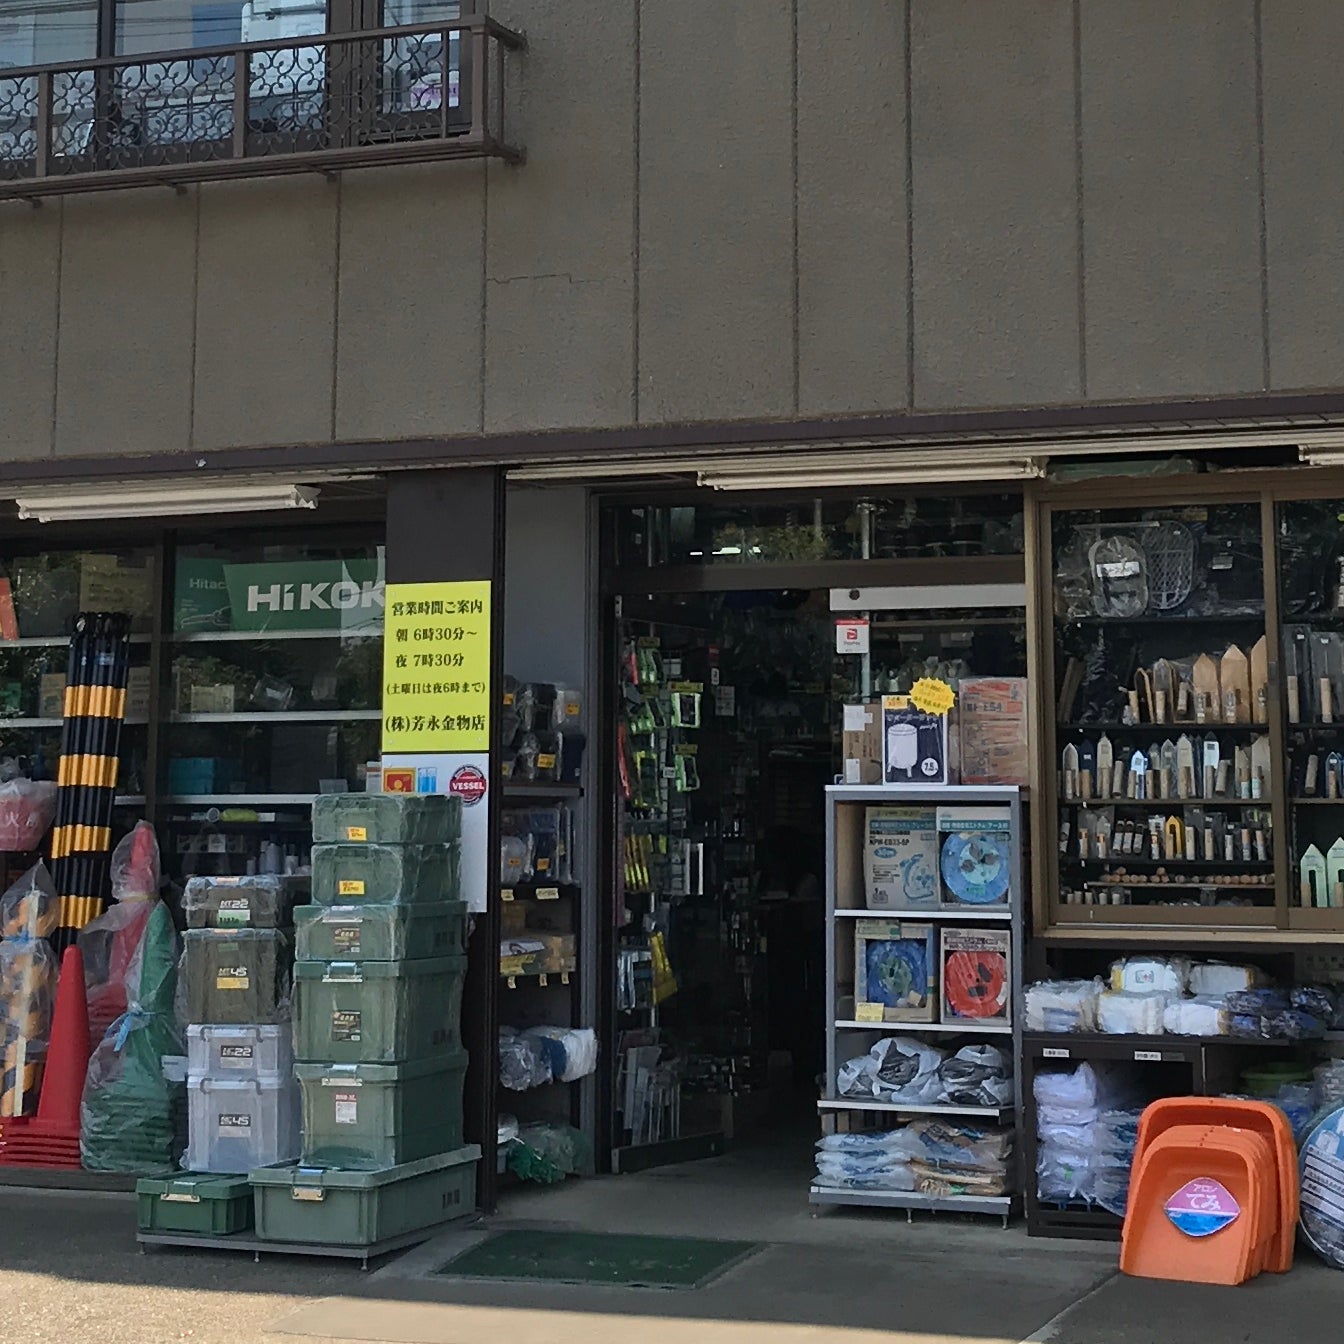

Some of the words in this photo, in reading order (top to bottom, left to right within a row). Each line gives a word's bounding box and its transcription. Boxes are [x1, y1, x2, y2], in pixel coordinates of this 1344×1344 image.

[391, 599, 483, 617] 営業時間ご案内
[396, 628, 408, 642] 朝
[396, 654, 408, 668] 夜
[413, 652, 465, 668] 7時30分
[452, 781, 485, 790] VESSEL
[1193, 1184, 1218, 1193] アロン
[1186, 1193, 1221, 1210] てみ
